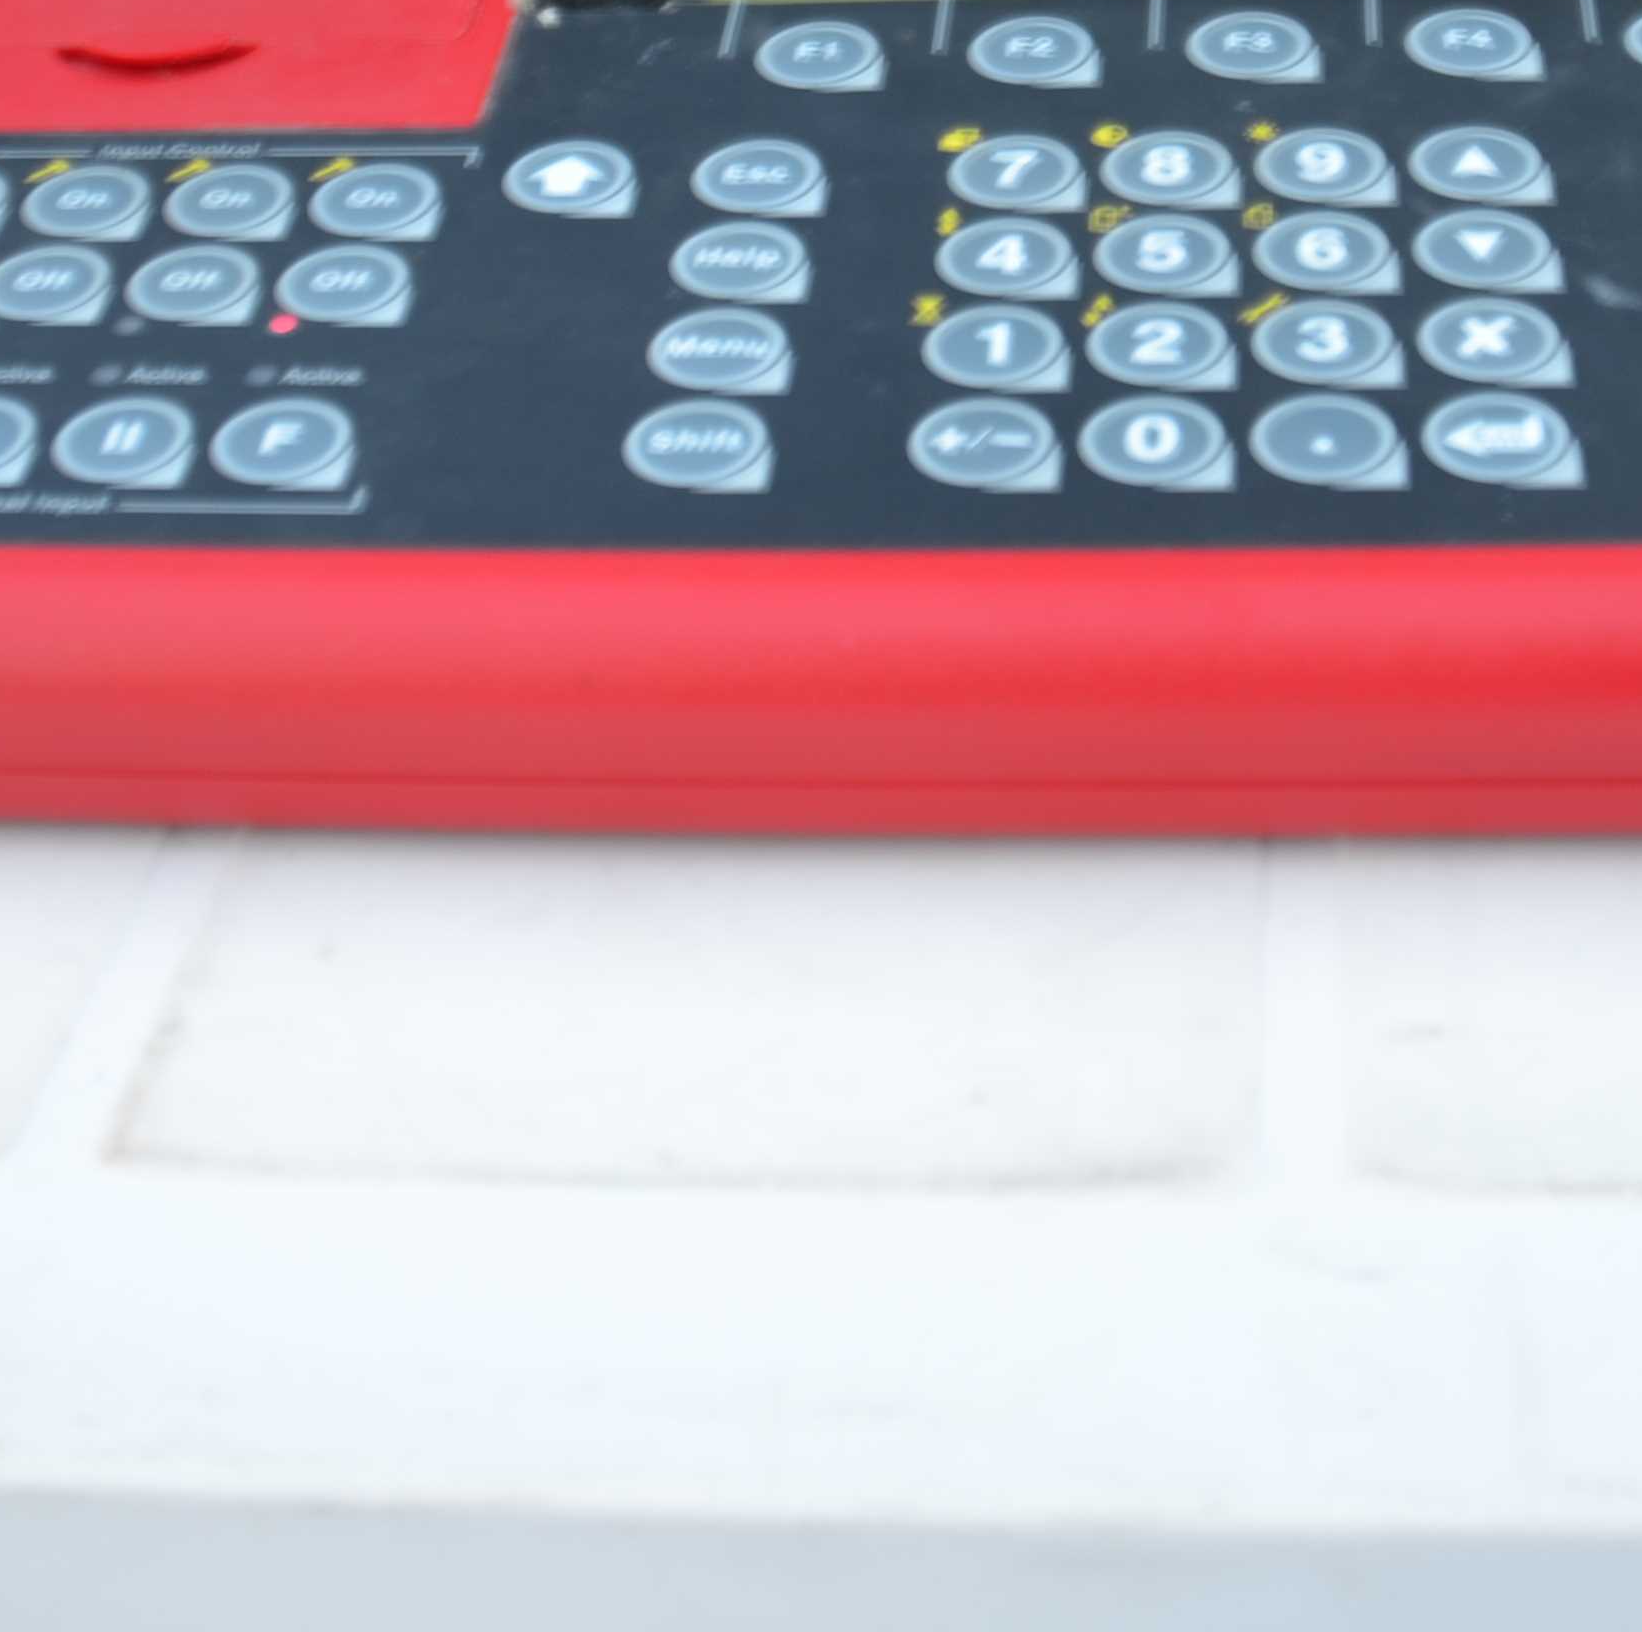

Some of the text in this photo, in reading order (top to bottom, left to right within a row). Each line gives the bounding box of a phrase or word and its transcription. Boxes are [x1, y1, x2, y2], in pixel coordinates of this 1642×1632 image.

[793, 40, 839, 62] F1
[1005, 35, 1055, 58] F2
[1224, 31, 1273, 52] F3
[1442, 28, 1492, 50] F4
[991, 149, 1041, 188] 7
[1140, 145, 1193, 187] 8
[1295, 142, 1349, 182] 9
[694, 245, 781, 271] Help
[974, 234, 1029, 276] 4
[1135, 230, 1191, 273] 5
[1295, 227, 1351, 270] 6
[667, 336, 770, 360] Menu
[975, 322, 1013, 364] 1
[1130, 318, 1185, 363] 2
[1294, 316, 1351, 362] 3
[257, 420, 303, 456] F
[646, 428, 745, 455] Shift
[1124, 416, 1181, 462] 0
